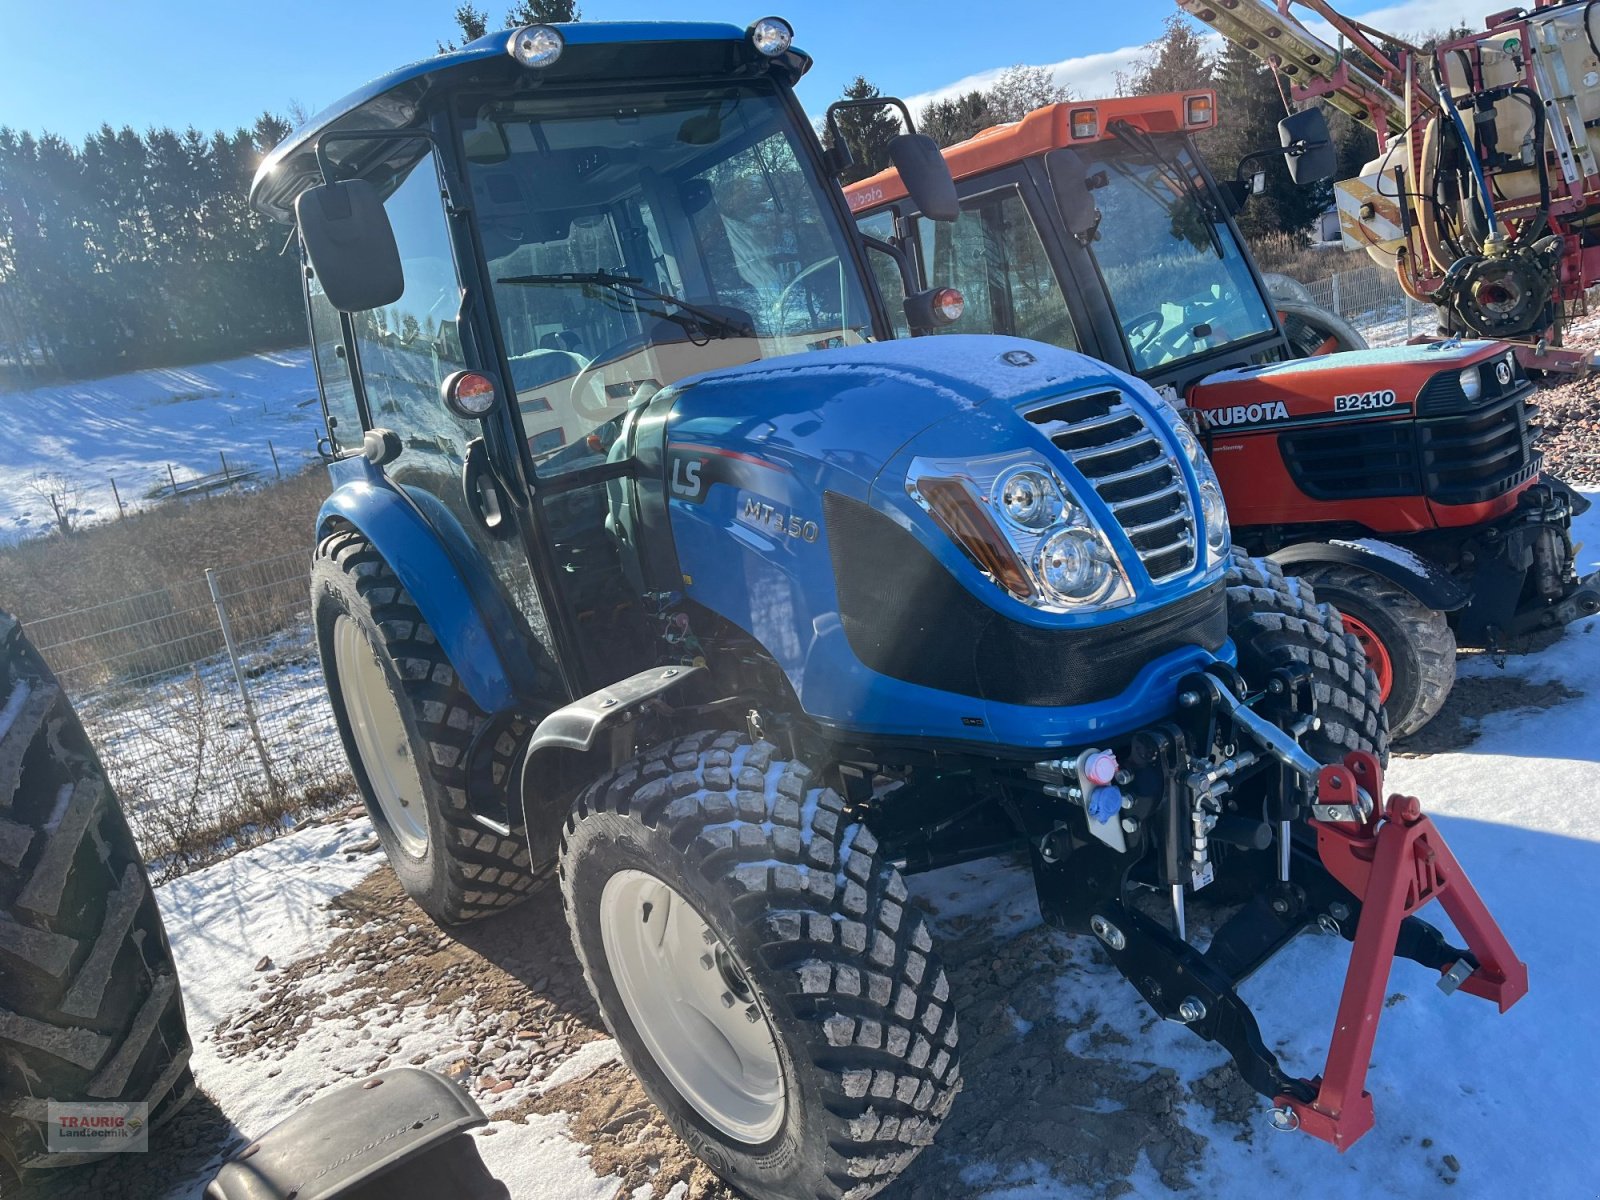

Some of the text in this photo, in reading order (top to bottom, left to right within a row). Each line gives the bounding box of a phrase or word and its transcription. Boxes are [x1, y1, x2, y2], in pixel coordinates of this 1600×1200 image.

[1203, 401, 1290, 427] KUBOTA
[1334, 389, 1397, 413] B2410
[672, 458, 702, 497] LS
[744, 498, 820, 544] MT3.50
